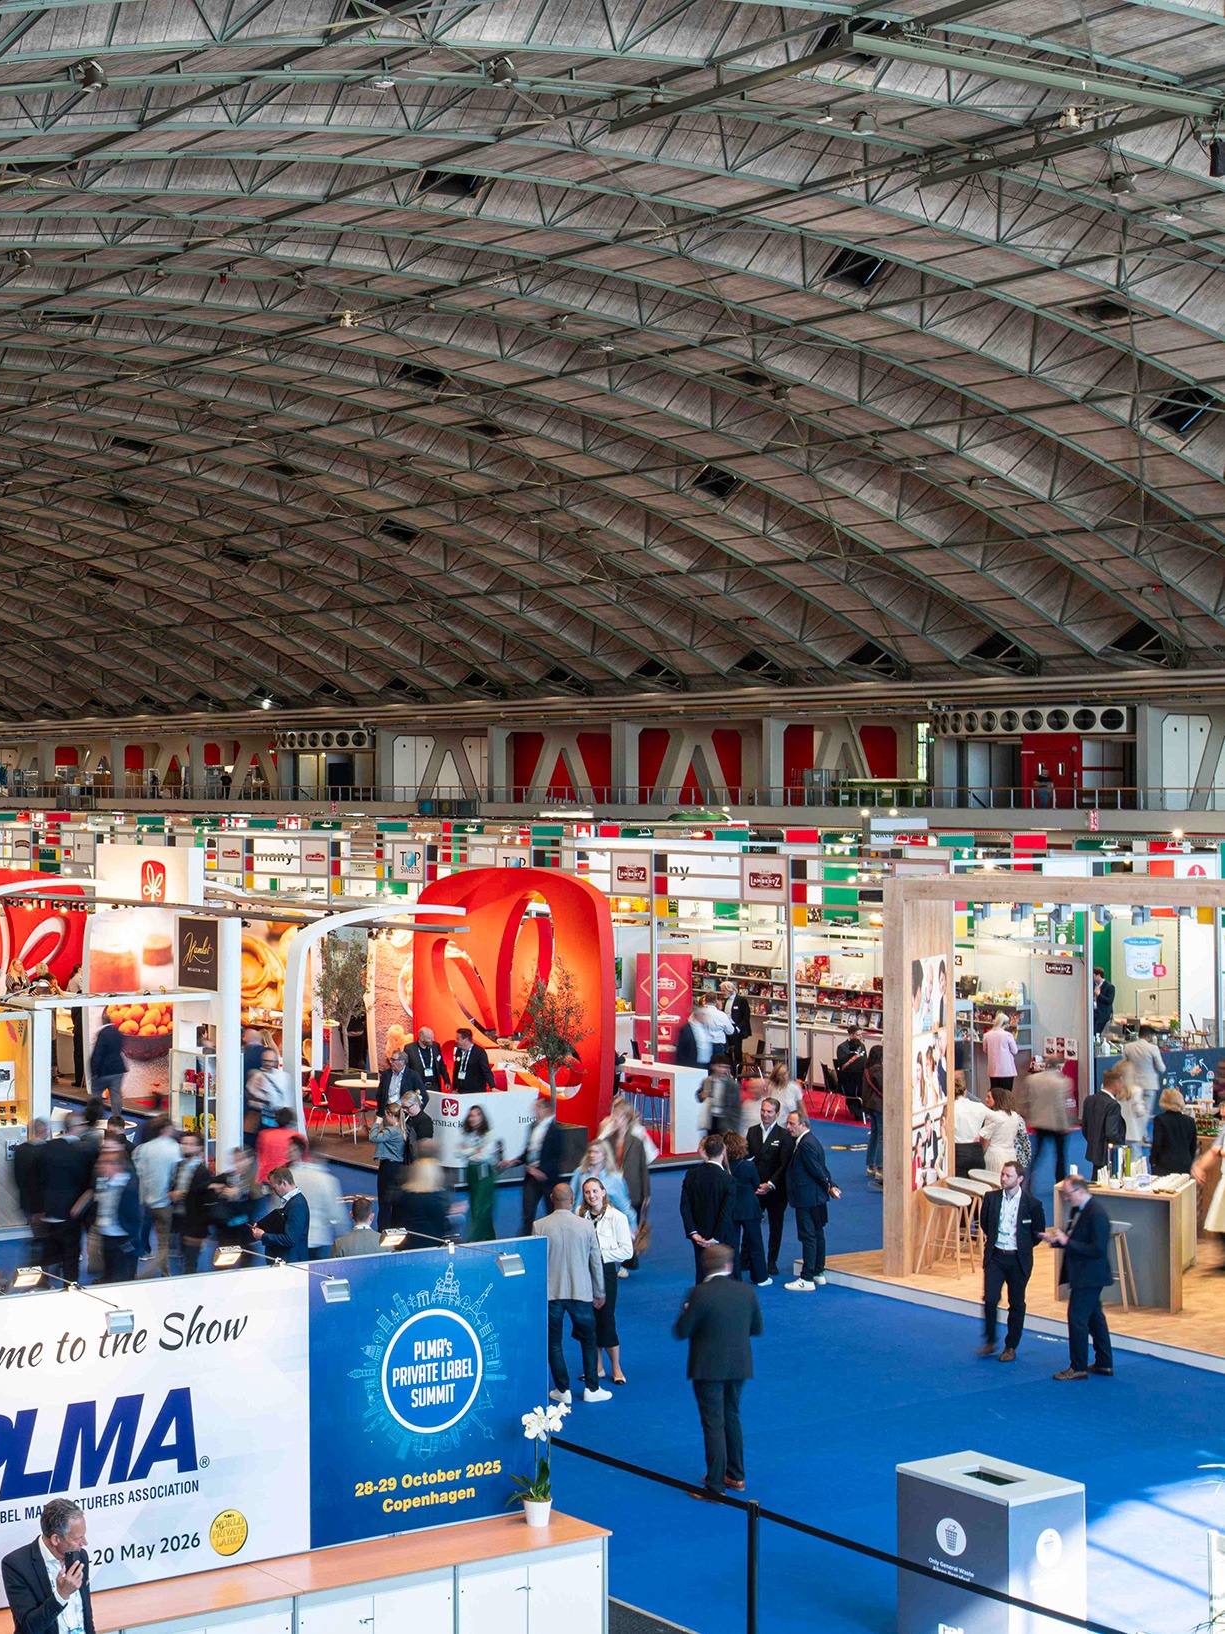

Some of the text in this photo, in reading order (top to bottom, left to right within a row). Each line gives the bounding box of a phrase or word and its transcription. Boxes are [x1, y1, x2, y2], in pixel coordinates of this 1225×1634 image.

[256, 853, 294, 865] many
[618, 868, 645, 880] LAMBERTZ
[750, 875, 782, 888] LAMBERTZ
[1046, 964, 1071, 974] LAMBERTZ
[57, 1331, 86, 1365] to
[159, 1305, 248, 1352] Show
[413, 1337, 453, 1362] PLMA's
[392, 1357, 475, 1388] PRIVATE LABEL
[411, 1383, 456, 1408] SUMMIT
[355, 1459, 502, 1498] 28-29 October 2025
[25, 1491, 124, 1520] MATURERS
[127, 1480, 199, 1504] ASSOCIATION
[382, 1488, 476, 1514] Copenhagen
[120, 1543, 155, 1562] May
[160, 1532, 201, 1554] 2026
[928, 1557, 974, 1578] Only General Waste
